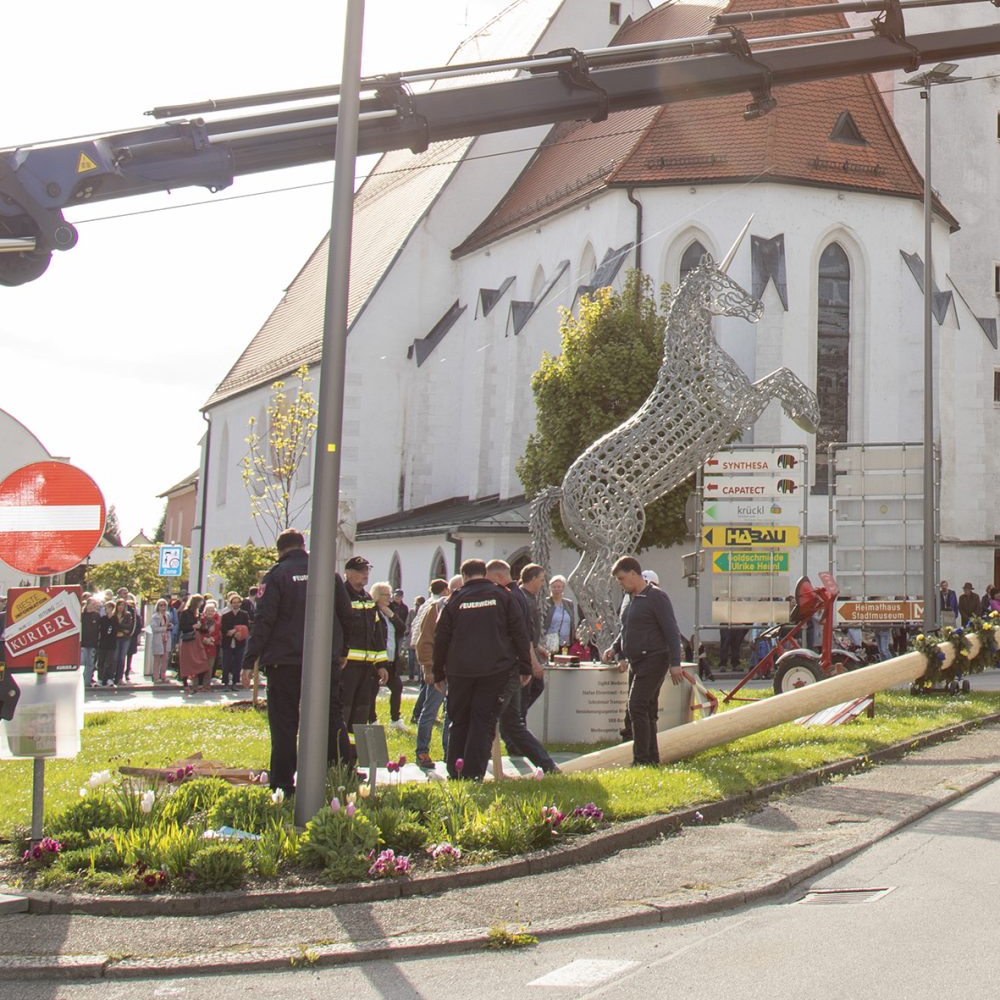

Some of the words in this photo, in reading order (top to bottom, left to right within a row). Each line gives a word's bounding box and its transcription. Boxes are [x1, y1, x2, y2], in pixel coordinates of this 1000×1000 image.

[722, 461, 769, 470] SYNTHESA
[722, 486, 766, 495] CAPATECT
[737, 505, 765, 515] krückl
[727, 528, 786, 545] HABAU
[731, 562, 755, 570] Ulrike
[459, 599, 497, 609] FEUERWEHR
[855, 603, 901, 611] Heimathaus
[851, 611, 905, 620] Stadtmuseum
[10, 615, 71, 650] KURIER
